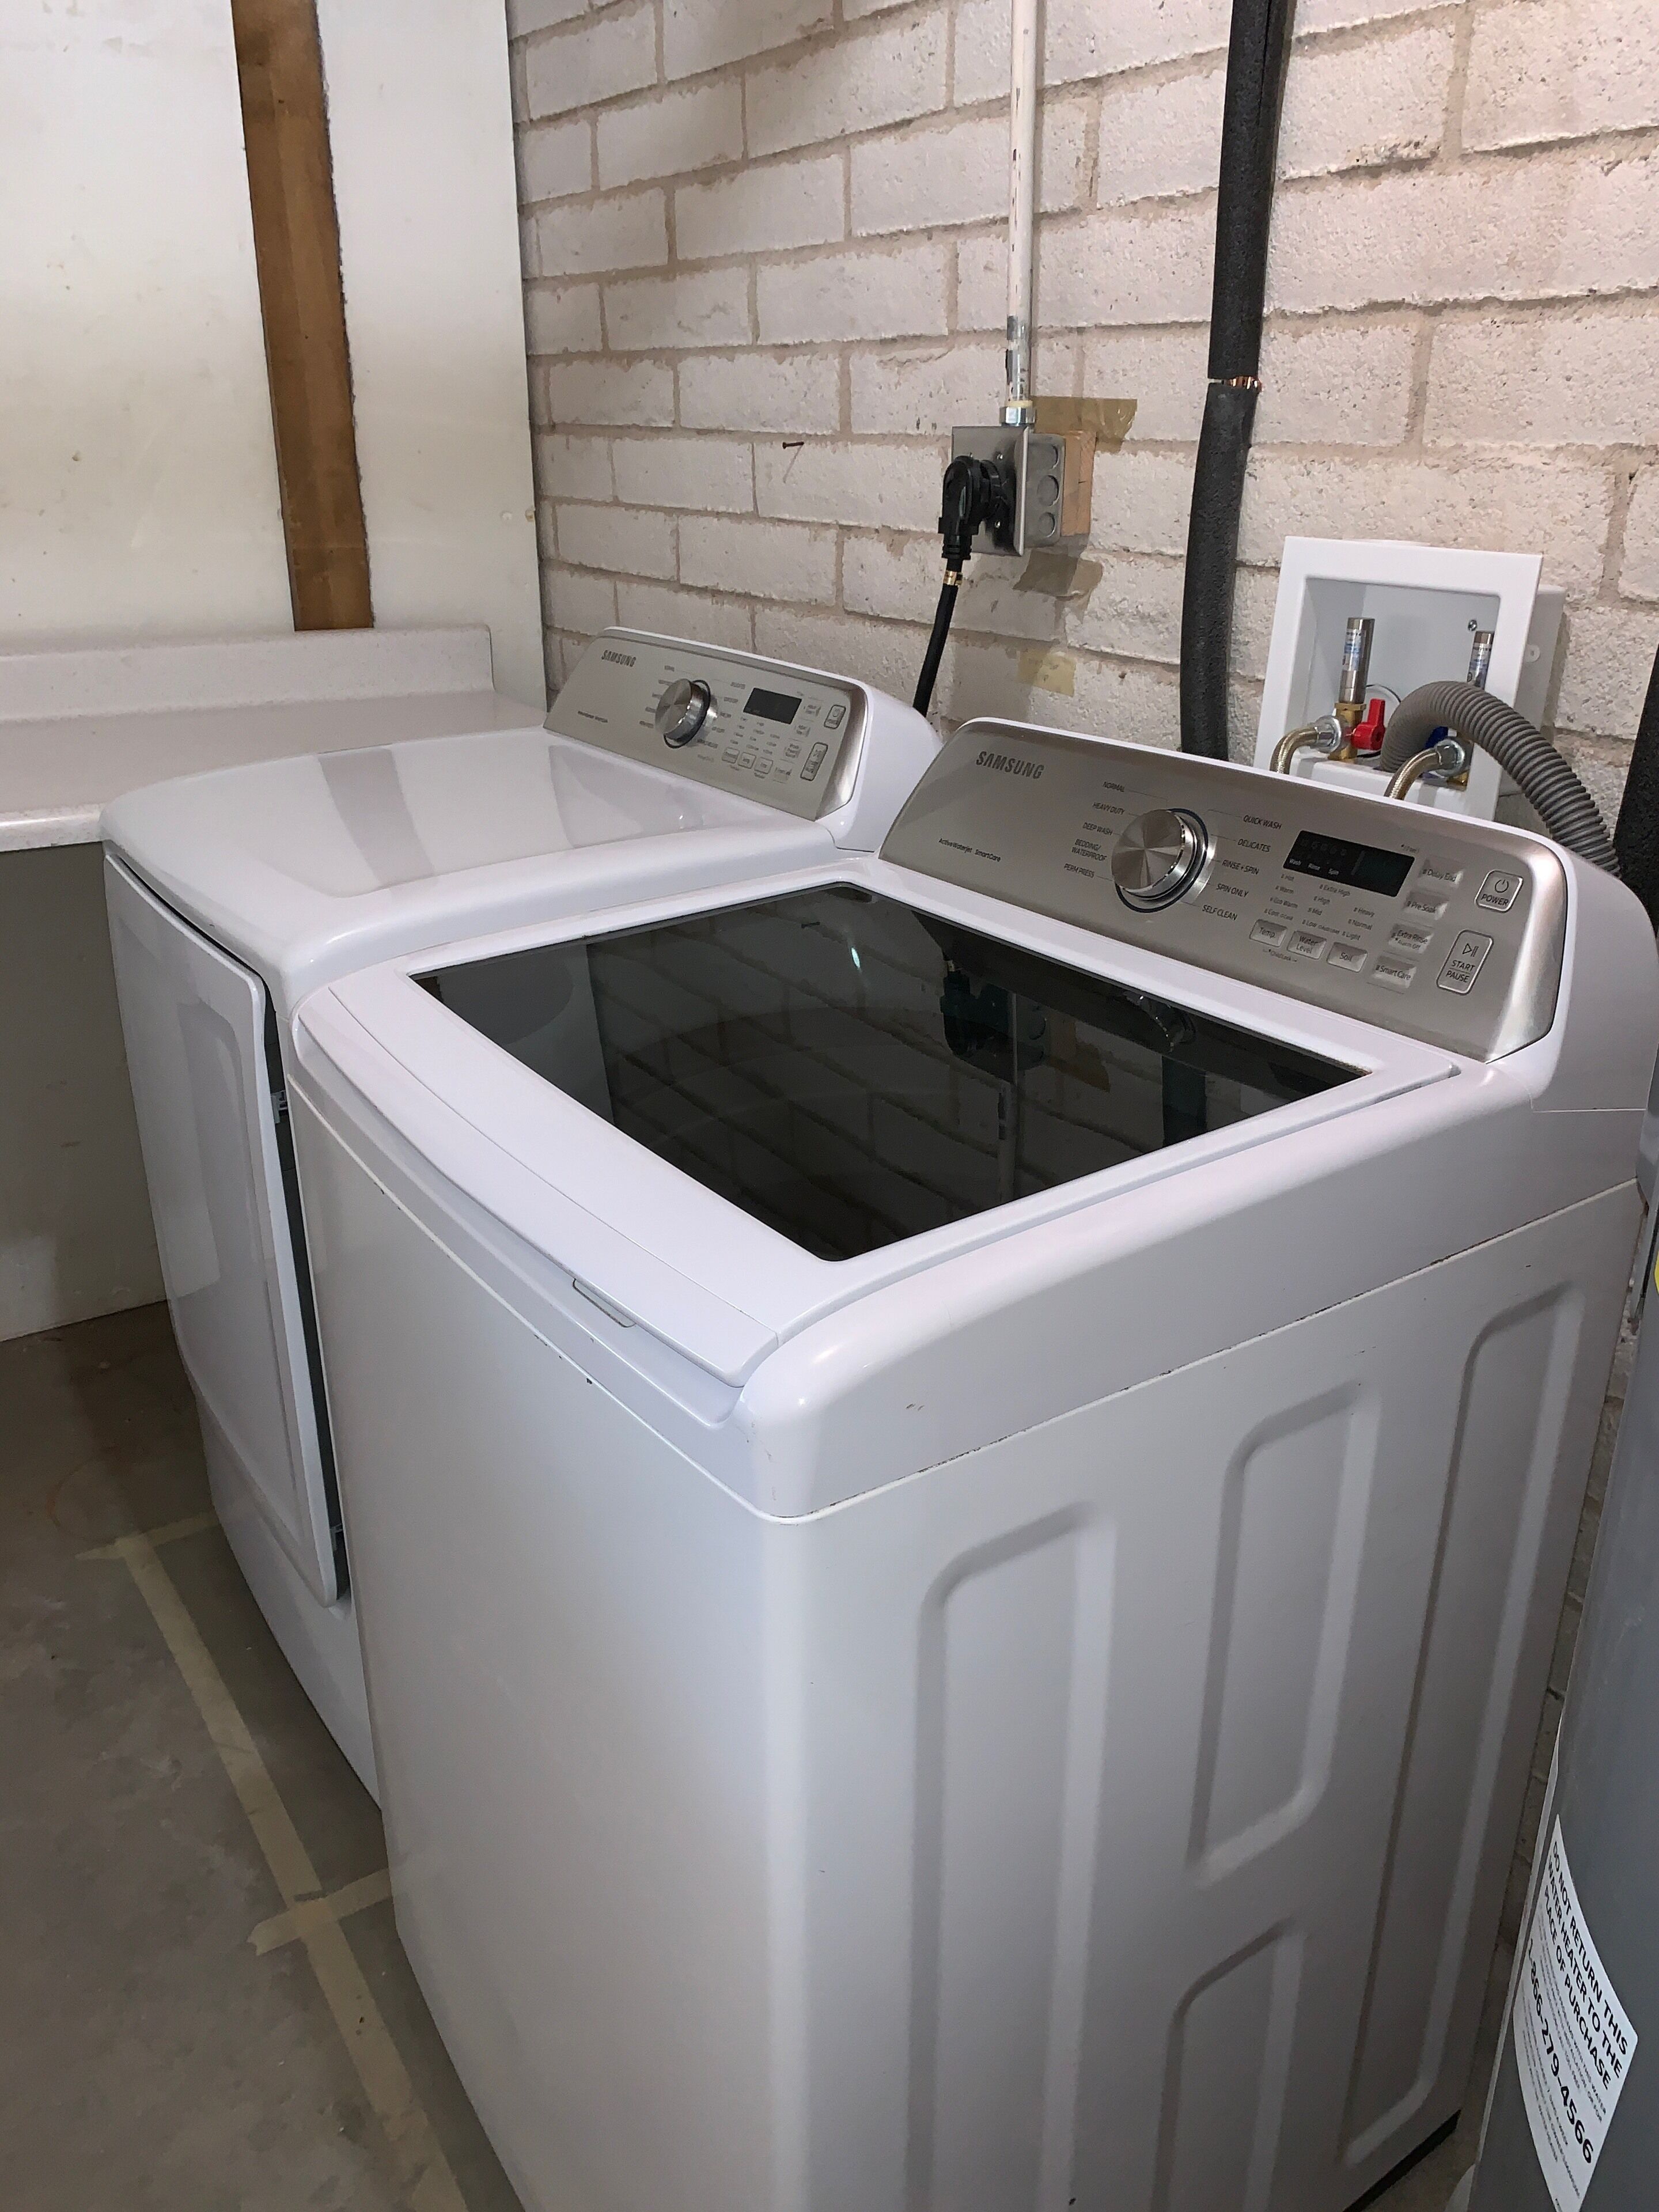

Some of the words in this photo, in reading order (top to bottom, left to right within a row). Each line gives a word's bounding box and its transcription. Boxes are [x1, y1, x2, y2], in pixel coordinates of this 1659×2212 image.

[601, 650, 636, 667] SAMSUNG
[976, 751, 1044, 779] SAMSUNG
[1103, 781, 1124, 792] NORMAL
[1092, 802, 1110, 813] HEAVY
[1082, 822, 1097, 831] DEEP
[1097, 826, 1113, 835] WASH
[1243, 815, 1262, 825] QUICK
[1263, 819, 1282, 830] WASH
[1075, 839, 1101, 851] BEDDING/
[1237, 839, 1271, 853] DELICATES
[1071, 847, 1107, 861] WATERPROOF
[1064, 863, 1078, 874] PERM
[1078, 867, 1094, 878] PRESS
[1222, 859, 1240, 870] RINSE
[1244, 865, 1259, 875] SPIN
[1427, 869, 1443, 880] Delay
[1444, 873, 1457, 882] End
[1216, 883, 1231, 892] SPIN
[1231, 888, 1249, 897] ONLY
[1481, 894, 1509, 906] POWER
[1202, 904, 1217, 915] SELF
[1217, 909, 1238, 921] CLEAN
[1411, 902, 1422, 910] Pre
[1422, 904, 1436, 914] Soak
[1353, 920, 1372, 930] Normal
[1299, 935, 1318, 946] Water
[1397, 930, 1412, 940] Extra
[1412, 934, 1428, 944] Rinse
[1297, 944, 1312, 954] Level
[1339, 952, 1353, 962] Soil
[1452, 960, 1476, 971] START
[1446, 970, 1470, 983] PAUSE
[1554, 1842, 1560, 1872] DO
[1559, 1872, 1571, 1915] NOT
[1570, 1916, 1602, 2003] RETURN
[1604, 1999, 1627, 2055] THIS
[1548, 1855, 1562, 1925] WATER
[1561, 1922, 1587, 2003] HEATER
[1588, 1997, 1600, 2033] TO
[1603, 2030, 1622, 2078] THE
[1545, 1885, 1557, 1945] PLACE
[1556, 1945, 1566, 1972] OF
[1565, 1974, 1611, 2090] PURCHASE
[1528, 1938, 1593, 2164] 1-866-279-4566
